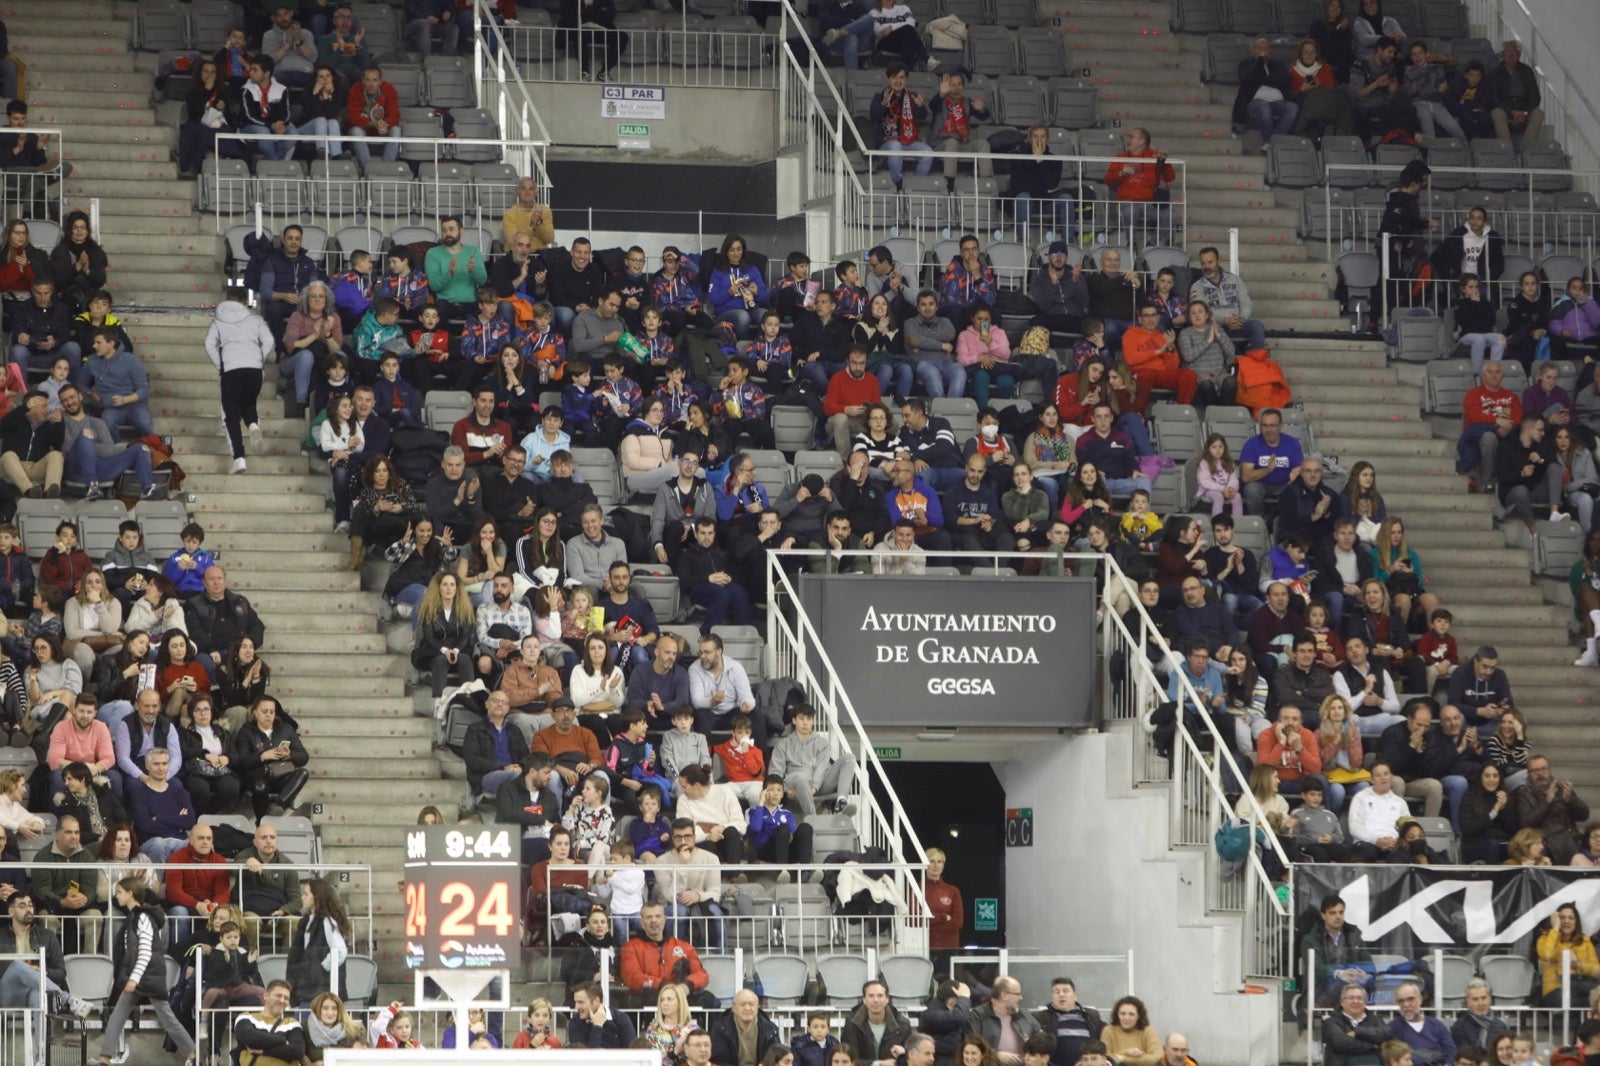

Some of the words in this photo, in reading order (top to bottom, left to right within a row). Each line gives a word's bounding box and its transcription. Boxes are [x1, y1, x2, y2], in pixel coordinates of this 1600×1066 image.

[606, 88, 621, 97] C3
[631, 89, 654, 99] PAR
[620, 126, 648, 135] SALIDA
[861, 605, 1057, 633] AYUNTAMIENTO
[876, 645, 909, 663] DE
[917, 637, 1040, 664] GRANADA
[445, 830, 512, 858] 9:44
[1021, 818, 1030, 845] C
[405, 882, 427, 937] 24
[440, 881, 514, 937] 24
